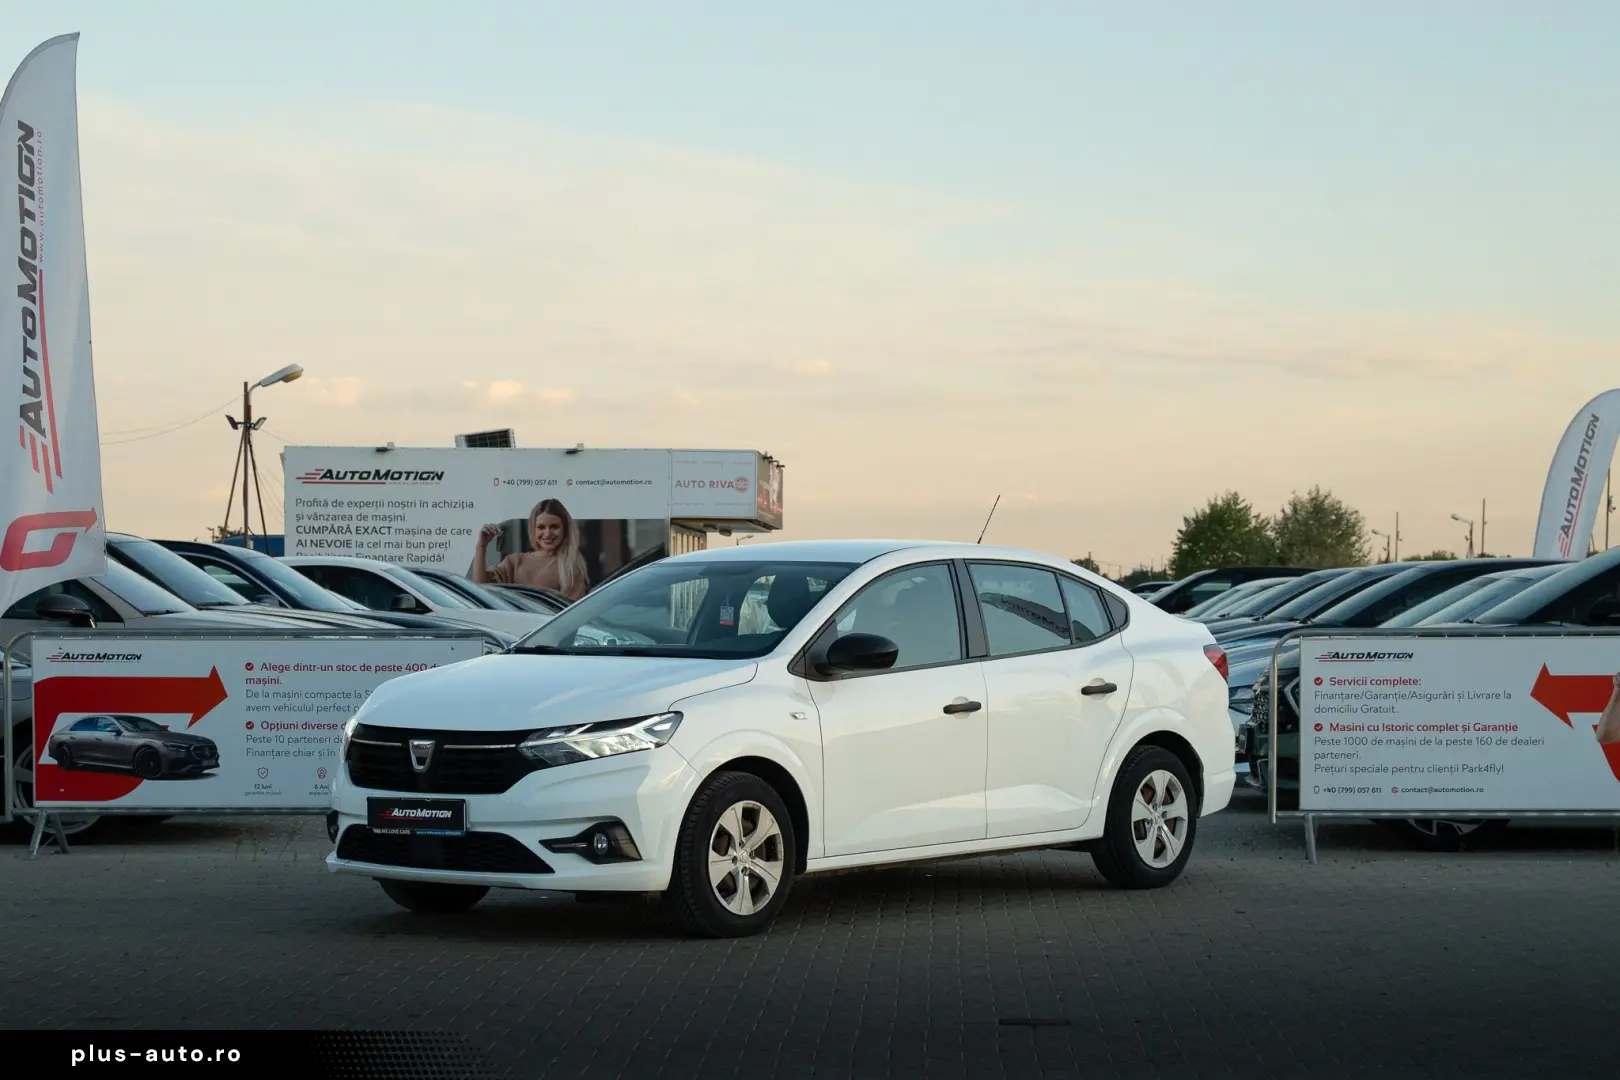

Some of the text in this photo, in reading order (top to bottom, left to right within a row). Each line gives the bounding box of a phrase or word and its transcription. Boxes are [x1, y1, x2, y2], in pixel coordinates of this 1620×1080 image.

[516, 478, 533, 487] (799)
[576, 478, 652, 487] contact@automotion.ro
[676, 480, 706, 488] AUTO
[296, 498, 474, 510] Profită de experții noștri în achiziția
[296, 512, 407, 523] și vânzarea de mașini.
[296, 524, 352, 534] CUMPĂRĂ
[356, 526, 392, 534] EXACT
[395, 527, 432, 538] mașina
[435, 526, 448, 536] de
[296, 539, 308, 548] AI
[310, 539, 352, 548] NEVOIE
[355, 539, 364, 548] la
[366, 539, 382, 548] cel
[384, 540, 402, 548] mai
[406, 540, 425, 548] bun
[406, 553, 444, 564] Rapidă!
[260, 662, 290, 672] Alege
[293, 662, 334, 672] dintr-un
[336, 664, 357, 672] stoc
[360, 663, 372, 672] de
[374, 664, 402, 673] peste
[405, 663, 428, 672] 400
[246, 676, 282, 686] mașini.
[1330, 677, 1422, 687] Servicii complete:
[246, 690, 260, 698] De
[262, 690, 270, 698] la
[272, 690, 302, 700] mașini
[304, 690, 352, 700] compacte
[354, 690, 362, 698] la
[1458, 690, 1464, 702] și
[1468, 691, 1500, 700] Livrare
[1504, 690, 1512, 700] la
[273, 703, 314, 712] vehiculul
[316, 703, 350, 714] perfect
[1314, 704, 1398, 714] domiciliu Gratuit.
[260, 721, 299, 732] Opțiuni
[301, 721, 338, 730] diverse
[1330, 722, 1364, 732] Masini
[1382, 722, 1414, 732] Istoric
[1416, 723, 1459, 733] complet
[1462, 723, 1470, 734] și
[1473, 722, 1518, 734] Garanție
[246, 735, 272, 744] Peste
[275, 735, 284, 744] 10
[288, 736, 330, 746] parteneri
[1314, 736, 1544, 748] Peste 1000 de mașini de la peste 160 de dealeri
[246, 748, 336, 760] Finanțare chiar și în
[1314, 751, 1361, 760] parteneri.
[1314, 764, 1504, 776] Prețuri speciale pentru clienții Park4fly!
[1338, 786, 1356, 794] (799)
